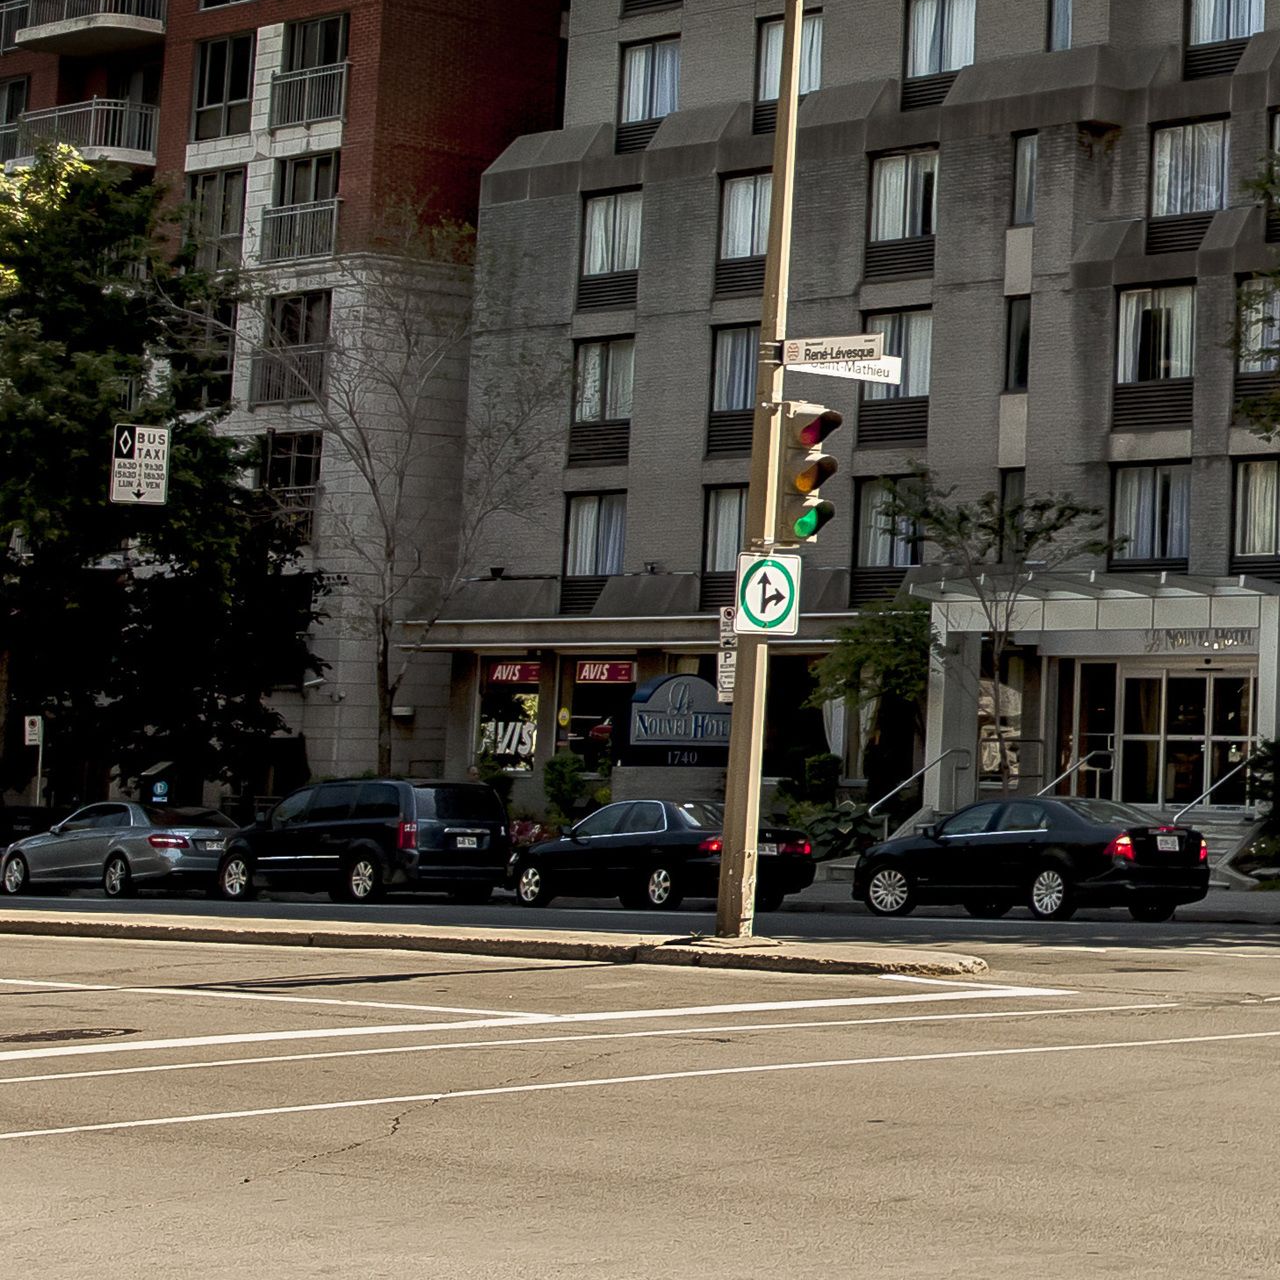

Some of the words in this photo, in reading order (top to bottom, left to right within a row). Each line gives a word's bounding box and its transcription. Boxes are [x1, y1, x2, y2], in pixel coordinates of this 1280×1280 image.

[804, 345, 875, 361] René-Lévesque
[137, 432, 166, 446] BUS
[137, 447, 165, 461] TAXI
[118, 479, 133, 488] LUN
[145, 481, 161, 489] VEN
[492, 664, 521, 681] AVIS
[580, 663, 610, 680] AVIS
[667, 751, 698, 765] 1740
